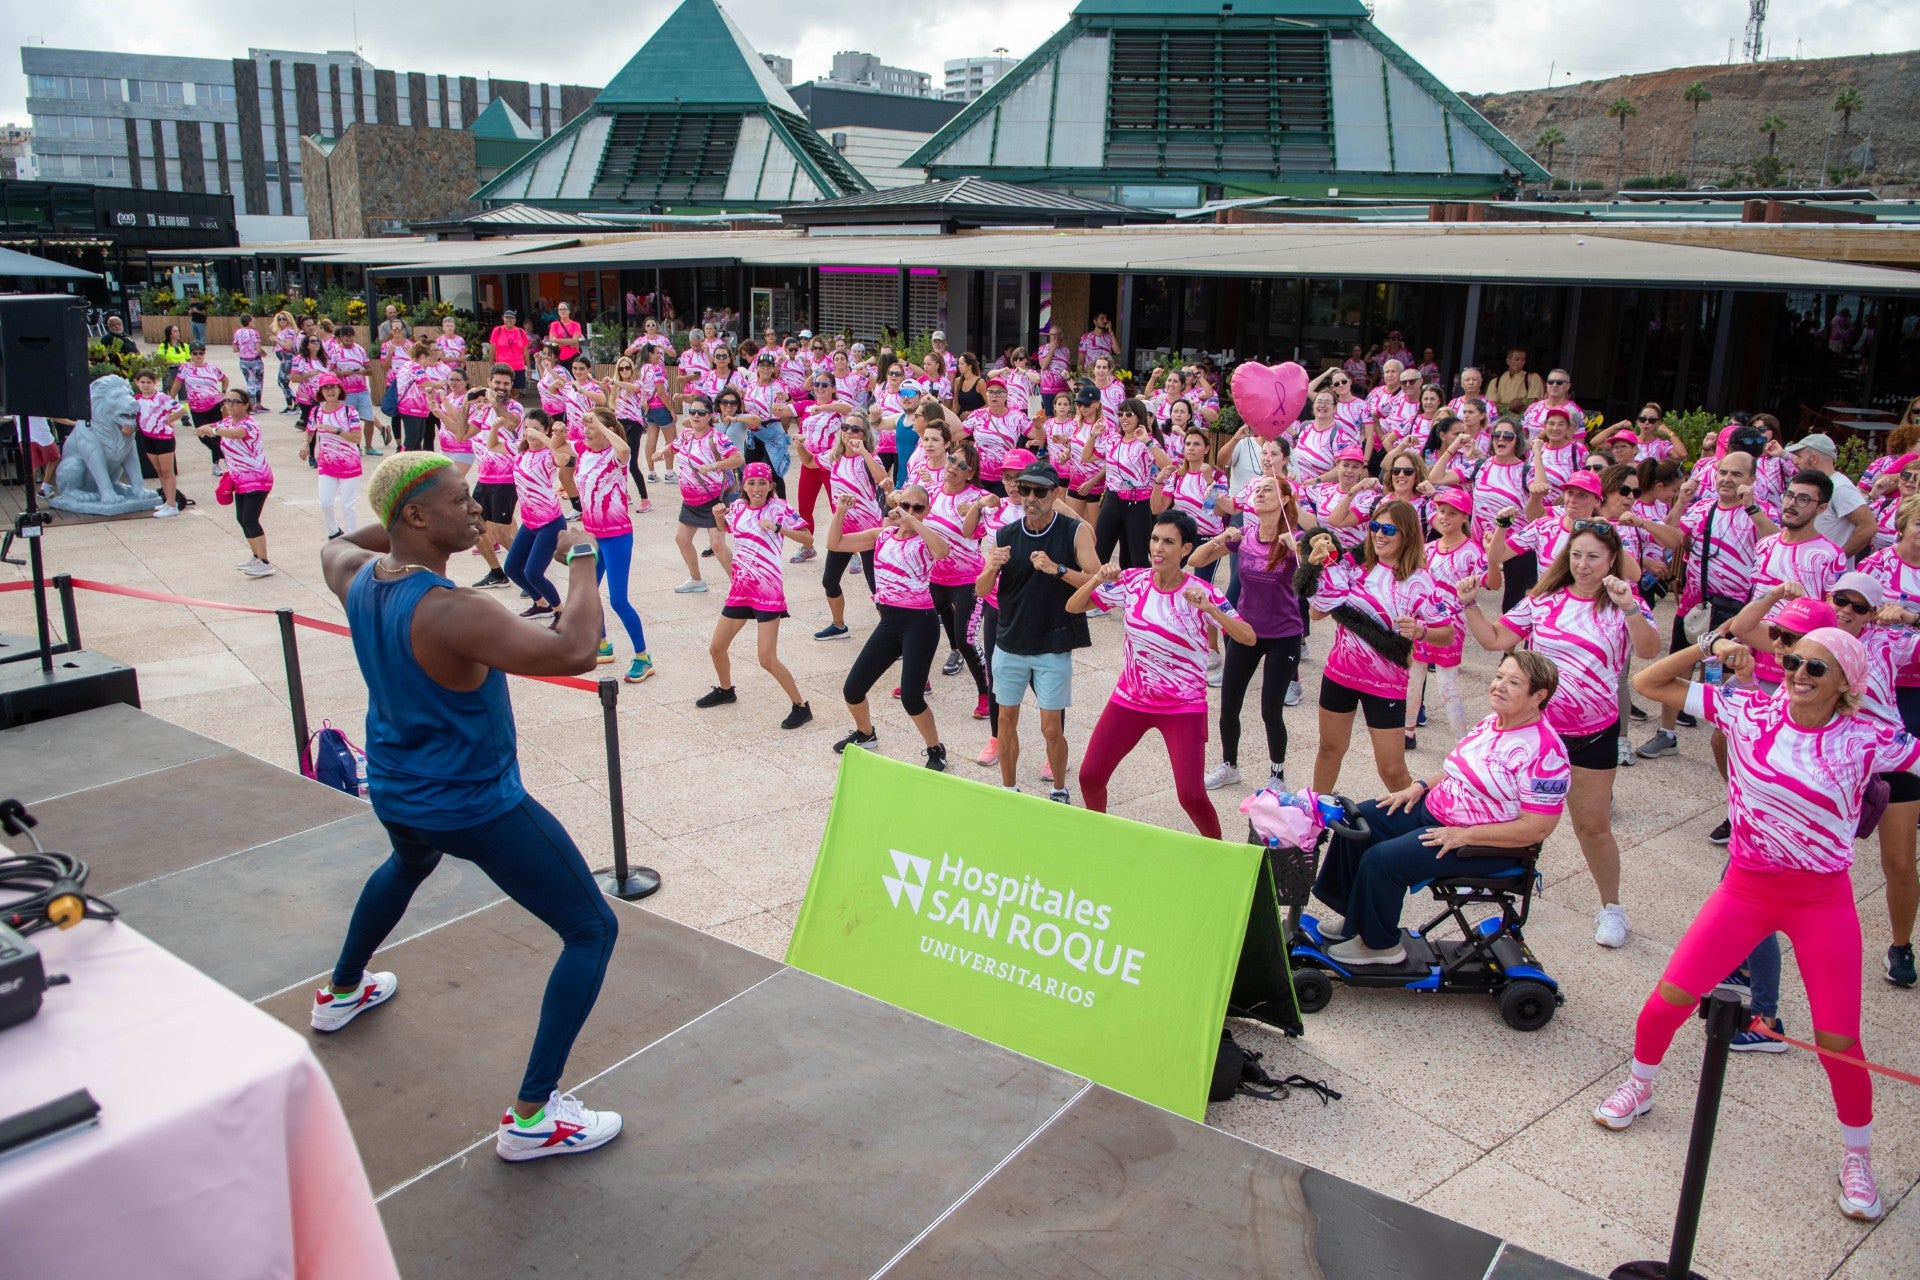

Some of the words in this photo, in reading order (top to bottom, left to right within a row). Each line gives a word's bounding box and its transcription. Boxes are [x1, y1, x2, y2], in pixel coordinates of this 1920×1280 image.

[938, 852, 1111, 930] Hospitales
[920, 936, 1095, 1008] UNIVERSITARIOS
[928, 890, 1000, 938] SAN
[1007, 914, 1145, 985] ROQUE
